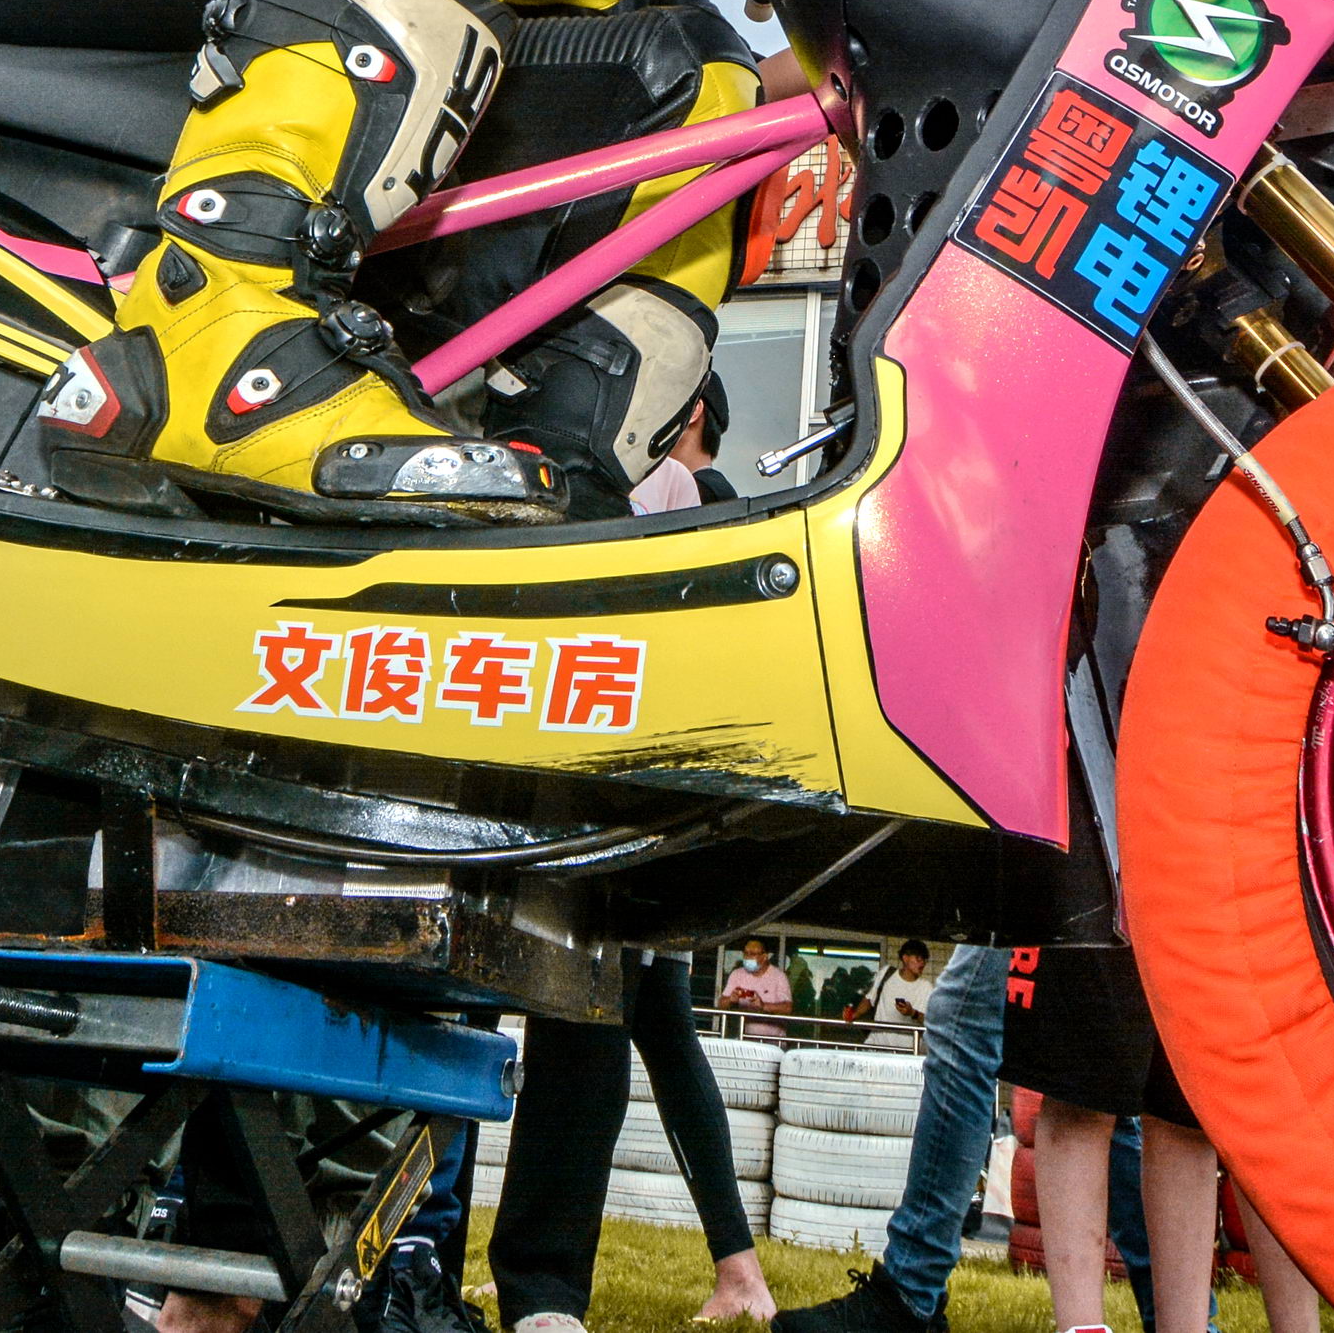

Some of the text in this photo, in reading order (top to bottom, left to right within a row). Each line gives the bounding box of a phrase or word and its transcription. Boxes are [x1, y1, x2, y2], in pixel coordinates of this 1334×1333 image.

[1110, 55, 1217, 132] QSMOTOR
[1073, 139, 1219, 337] 锂电
[234, 620, 647, 734] 文俊车房
